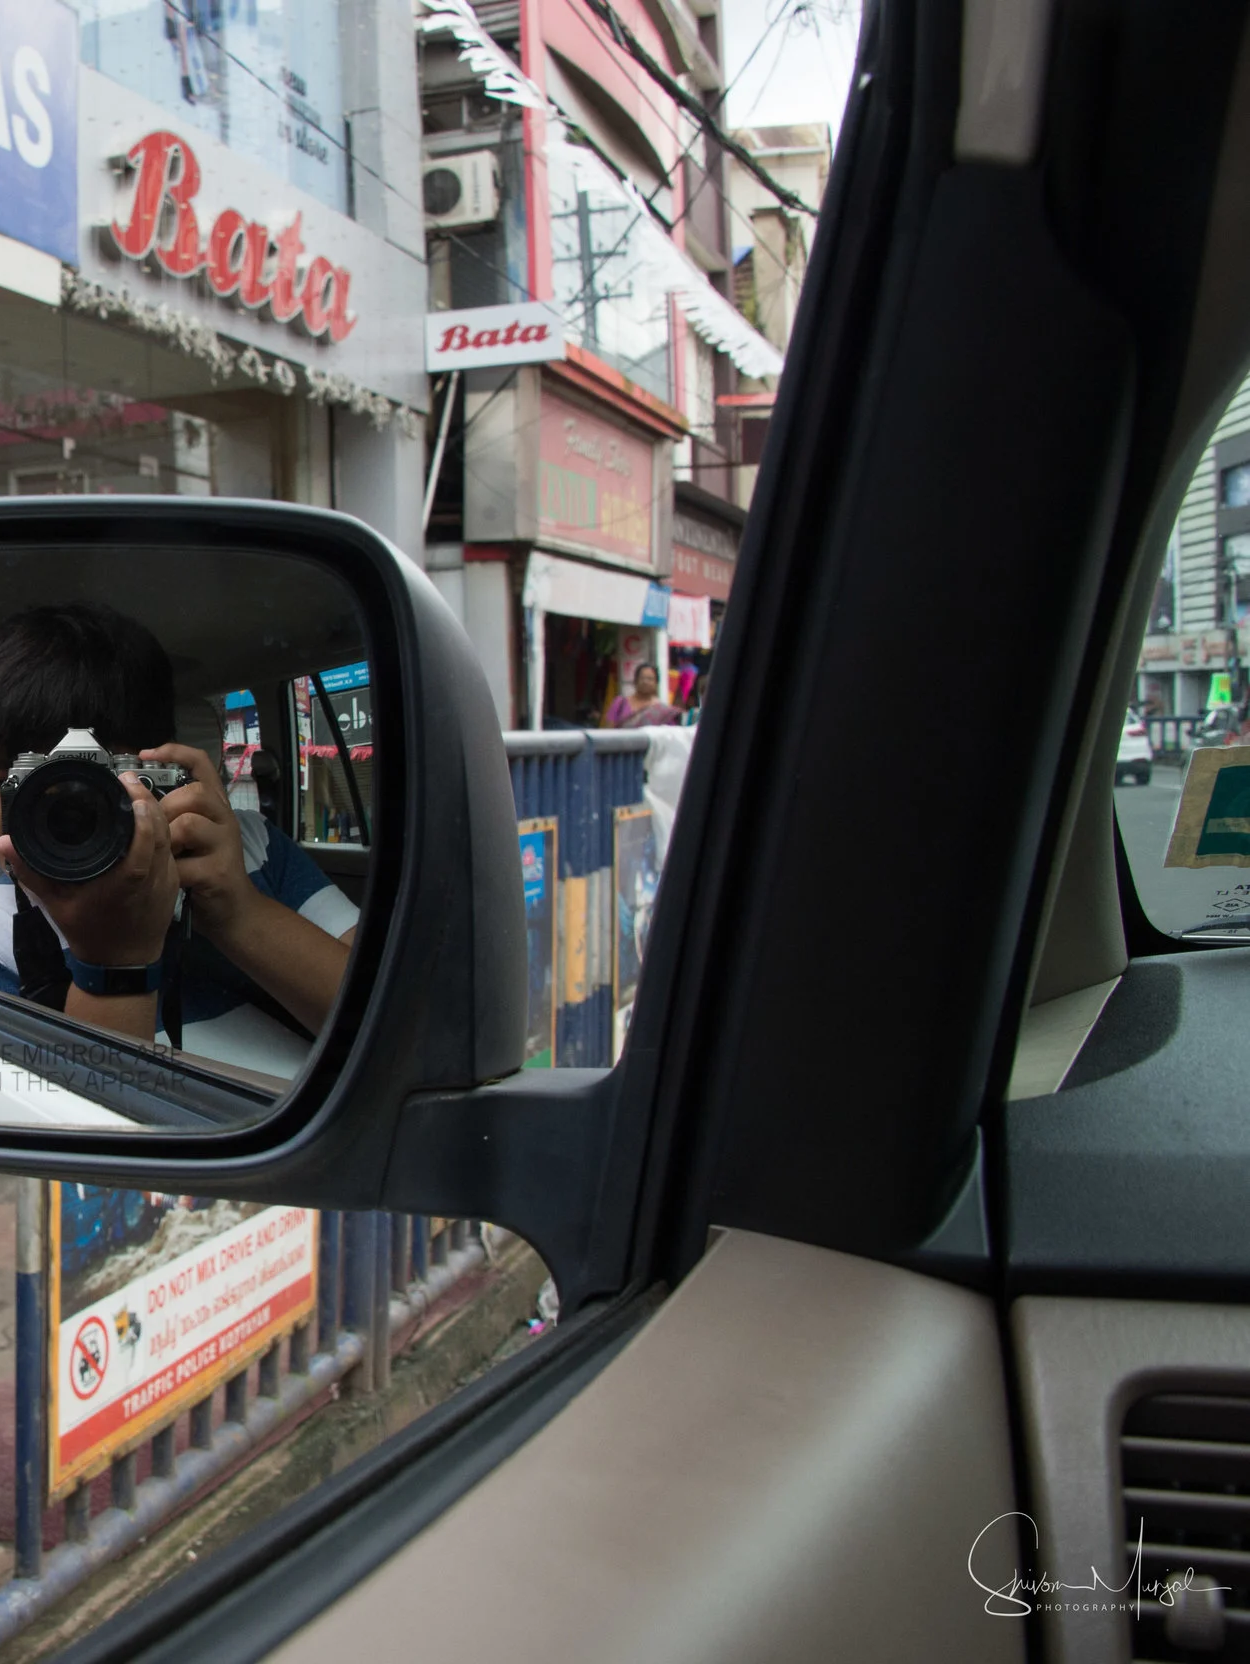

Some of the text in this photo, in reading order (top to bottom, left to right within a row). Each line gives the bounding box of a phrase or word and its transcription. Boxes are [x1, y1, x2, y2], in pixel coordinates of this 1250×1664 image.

[112, 129, 358, 342] Bata
[434, 319, 552, 356] Bata
[11, 1070, 77, 1092] THEY
[84, 1071, 188, 1092] APPEAR
[22, 1043, 124, 1065] MIRROR
[134, 1043, 183, 1065] ARE
[147, 1286, 165, 1315] DO
[168, 1266, 194, 1297] NOT
[196, 1254, 218, 1286] MIX
[219, 1234, 254, 1273] DRIVE
[255, 1220, 277, 1250] AND
[121, 1371, 175, 1420] TRAFFIC
[175, 1340, 218, 1385] POLICE
